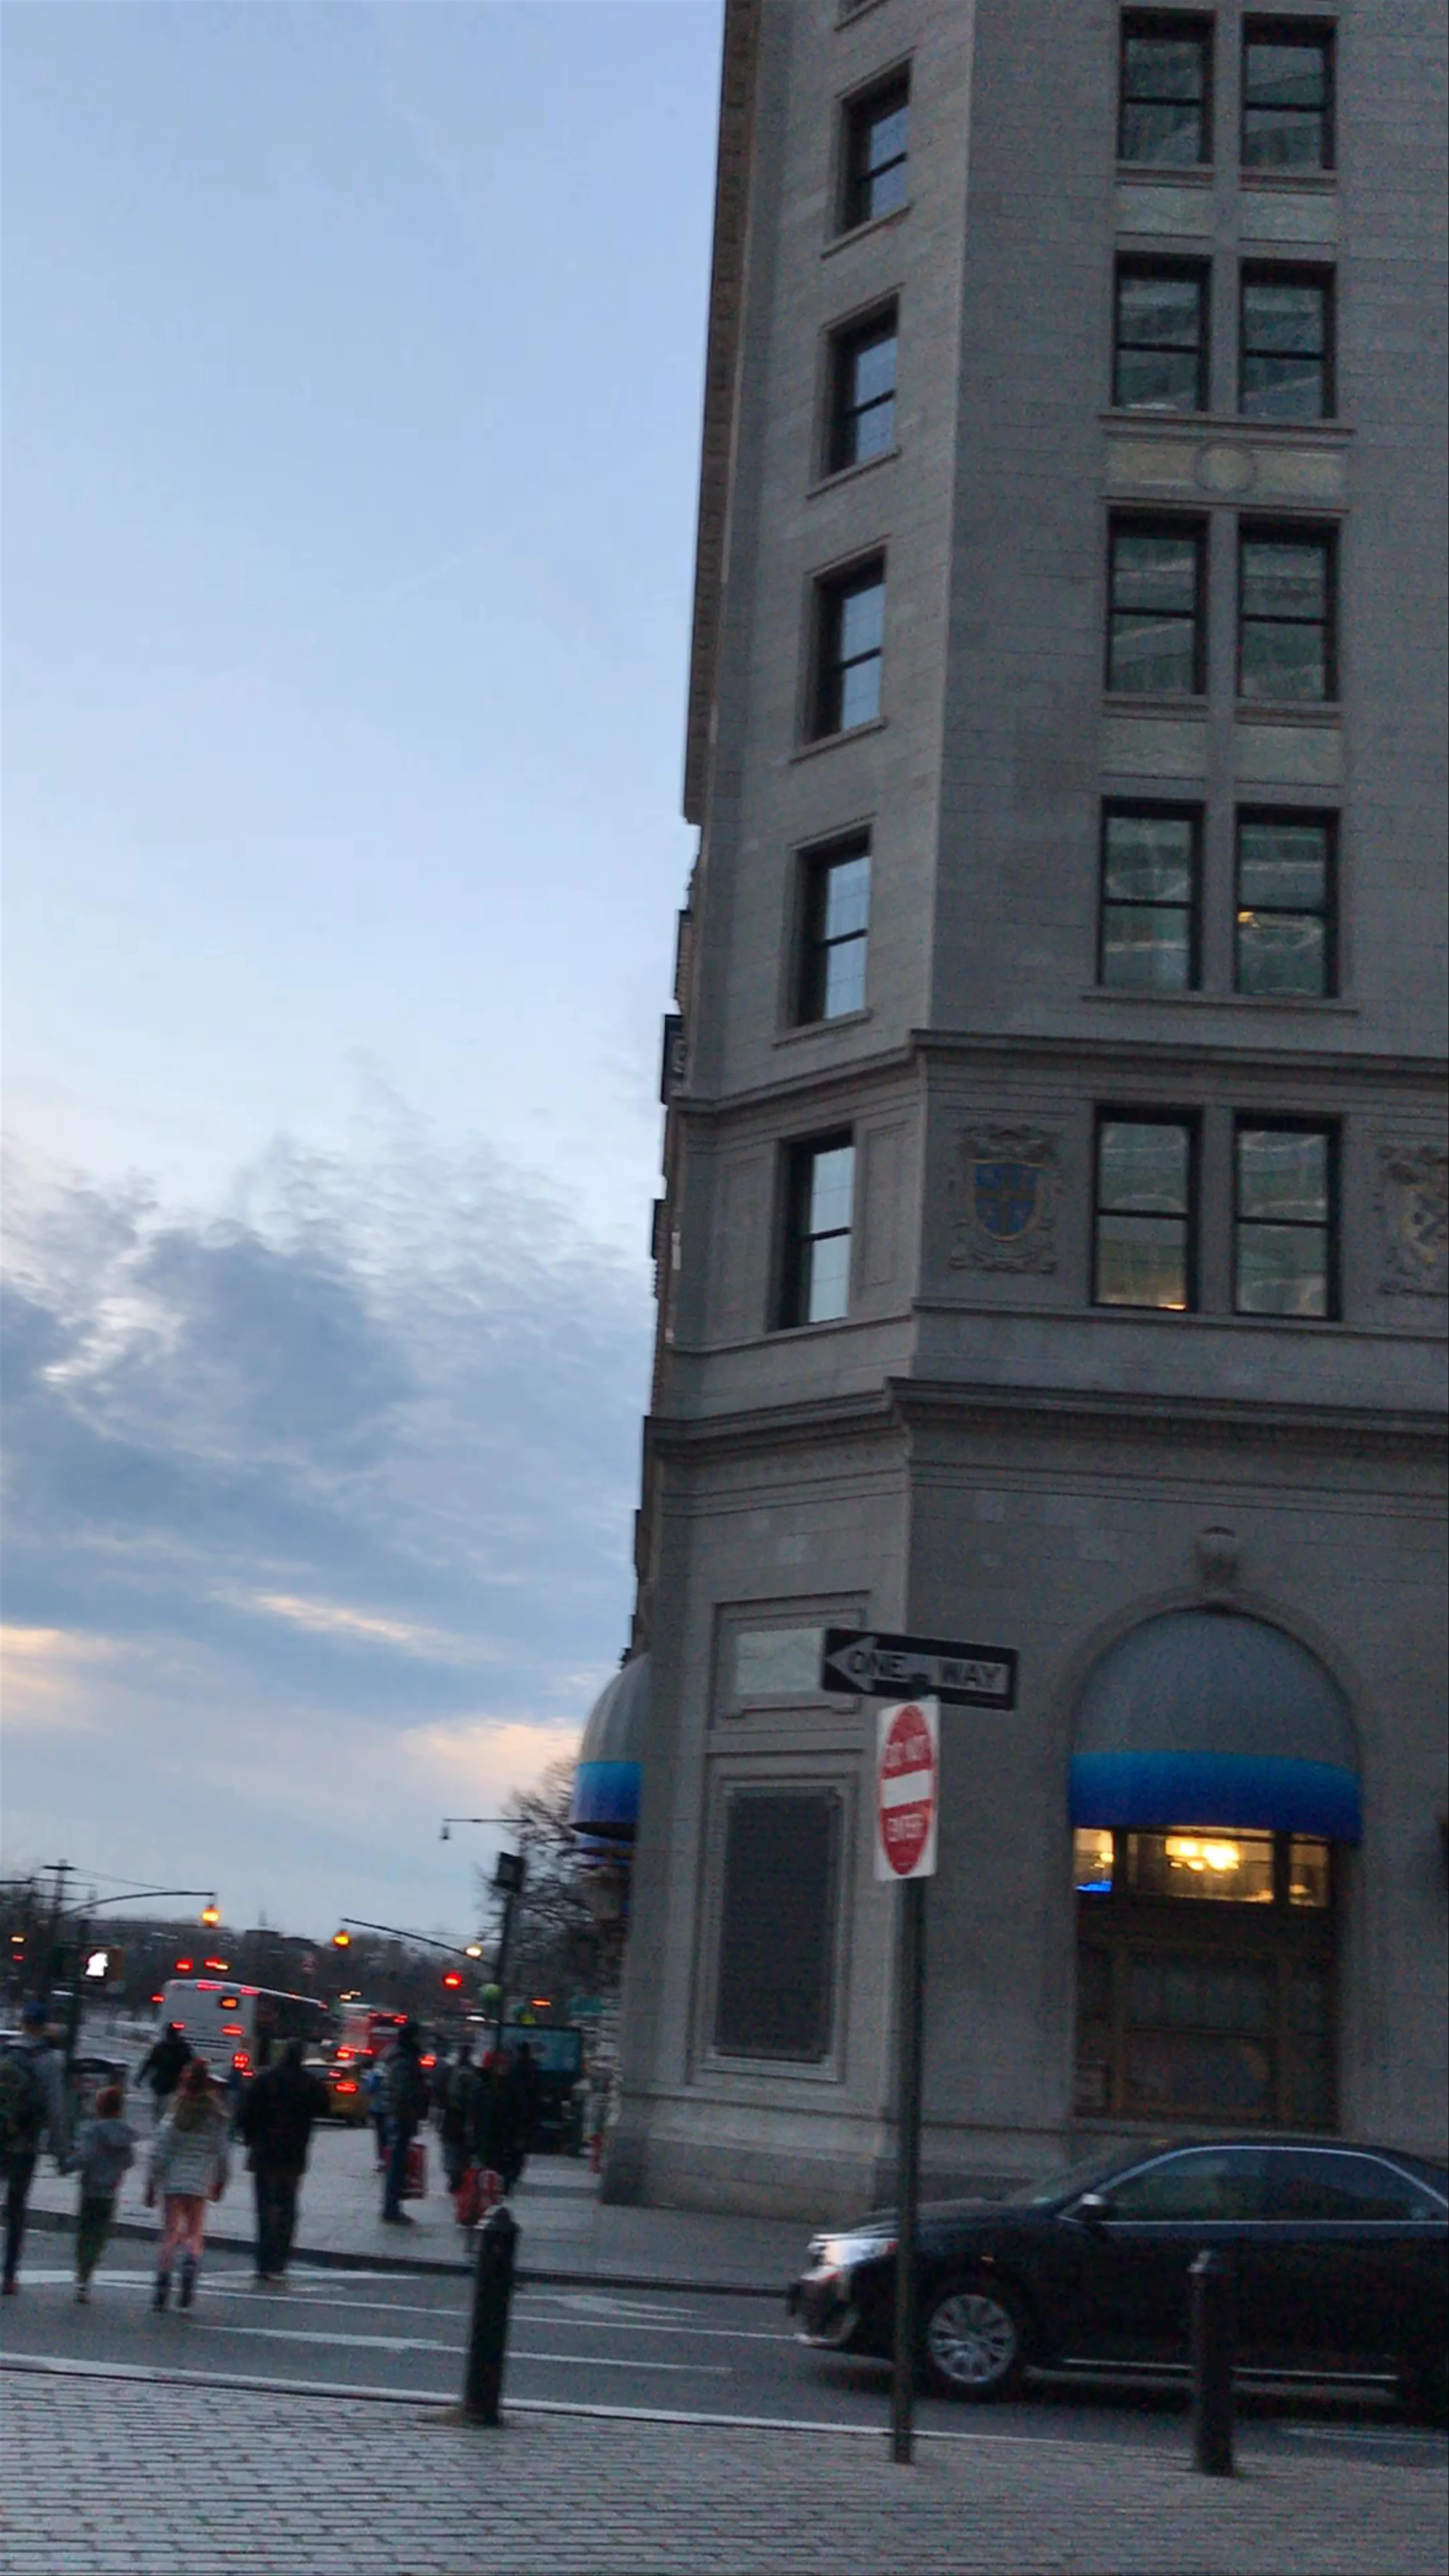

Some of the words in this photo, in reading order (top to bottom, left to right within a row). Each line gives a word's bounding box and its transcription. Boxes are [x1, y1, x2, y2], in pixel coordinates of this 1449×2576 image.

[847, 1649, 906, 1679] ONE
[942, 1661, 1002, 1688] WAY
[904, 1735, 927, 1762] NOT
[887, 1813, 924, 1843] ENTER
